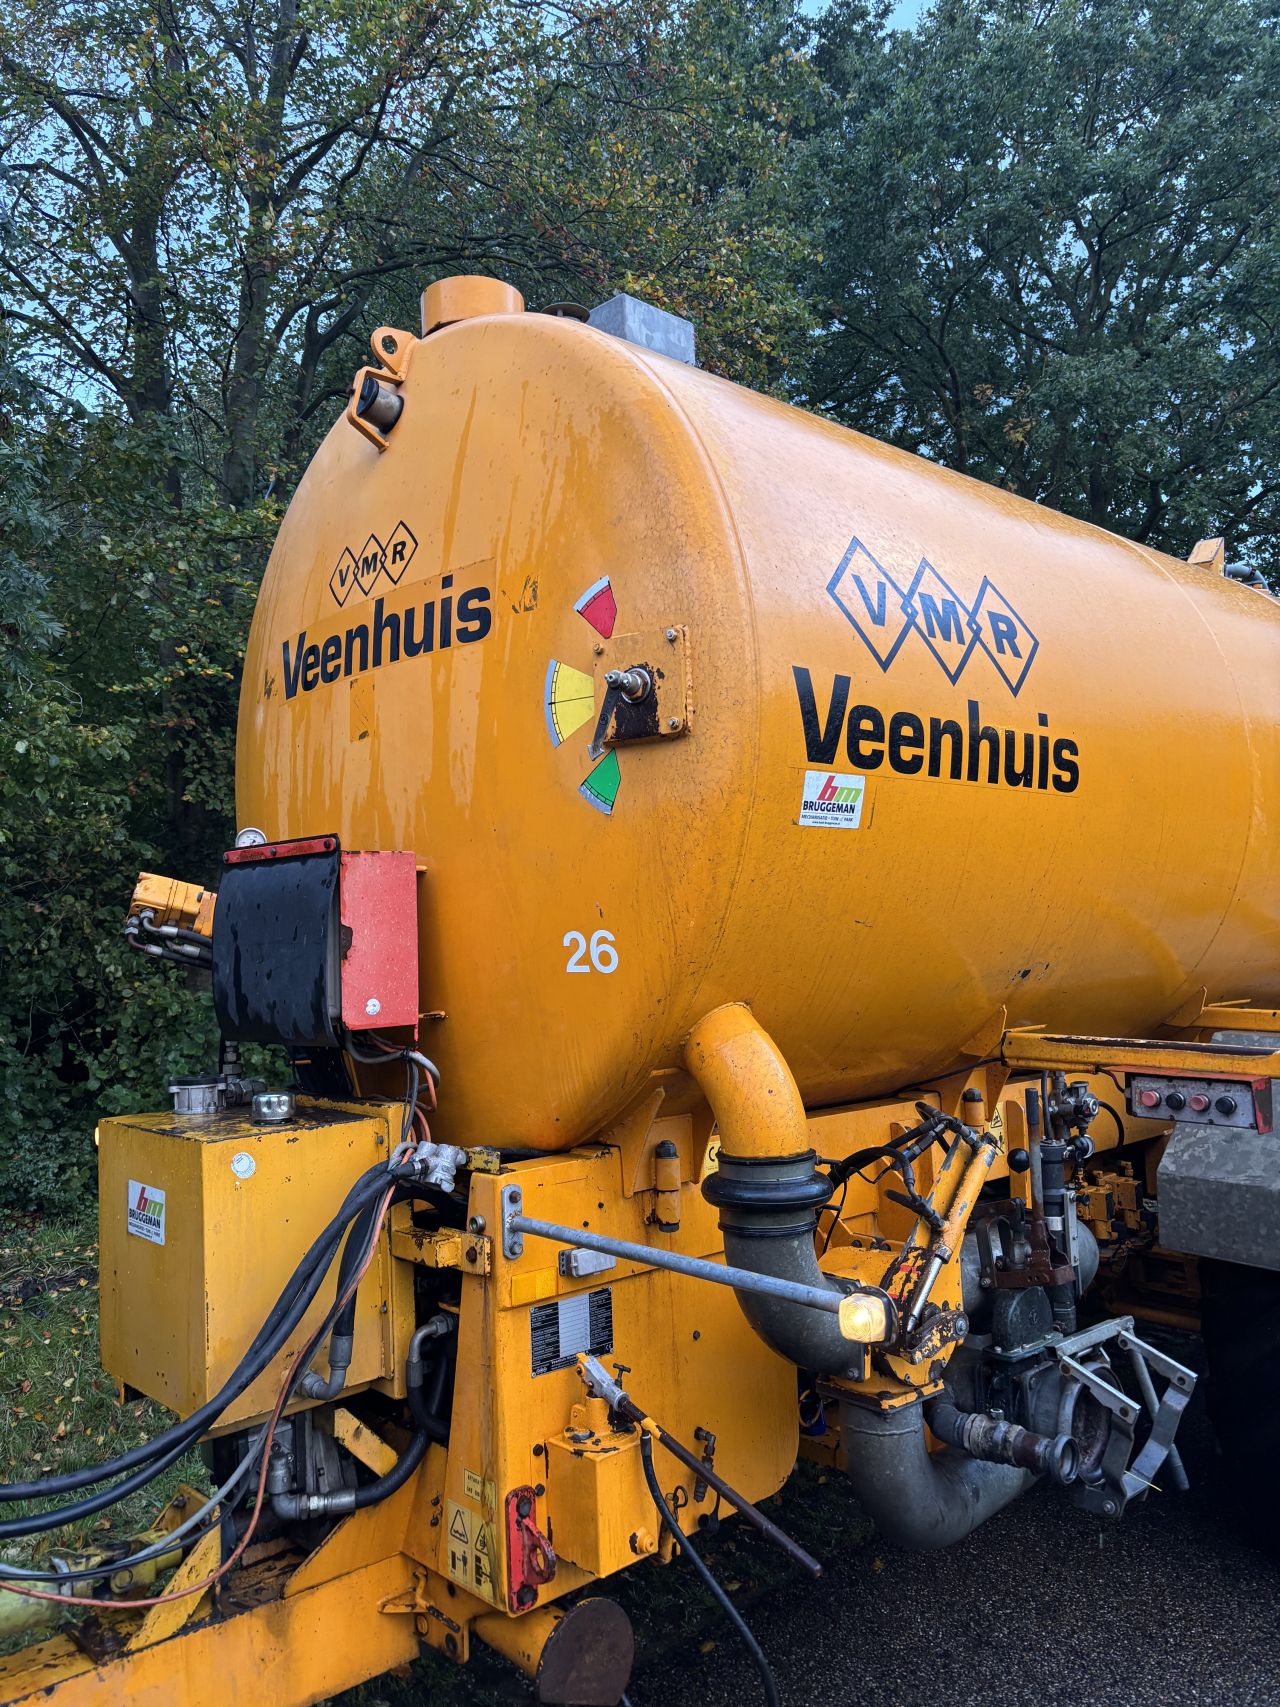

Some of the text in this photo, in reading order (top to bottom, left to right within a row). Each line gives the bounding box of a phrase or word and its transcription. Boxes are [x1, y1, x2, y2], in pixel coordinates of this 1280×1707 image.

[282, 574, 492, 700] Veenhuis
[791, 665, 1080, 793] Veenhuis
[802, 800, 856, 814] BRUGGEMAN
[563, 929, 619, 974] 26
[129, 1208, 161, 1229] BRUGGEMAN
